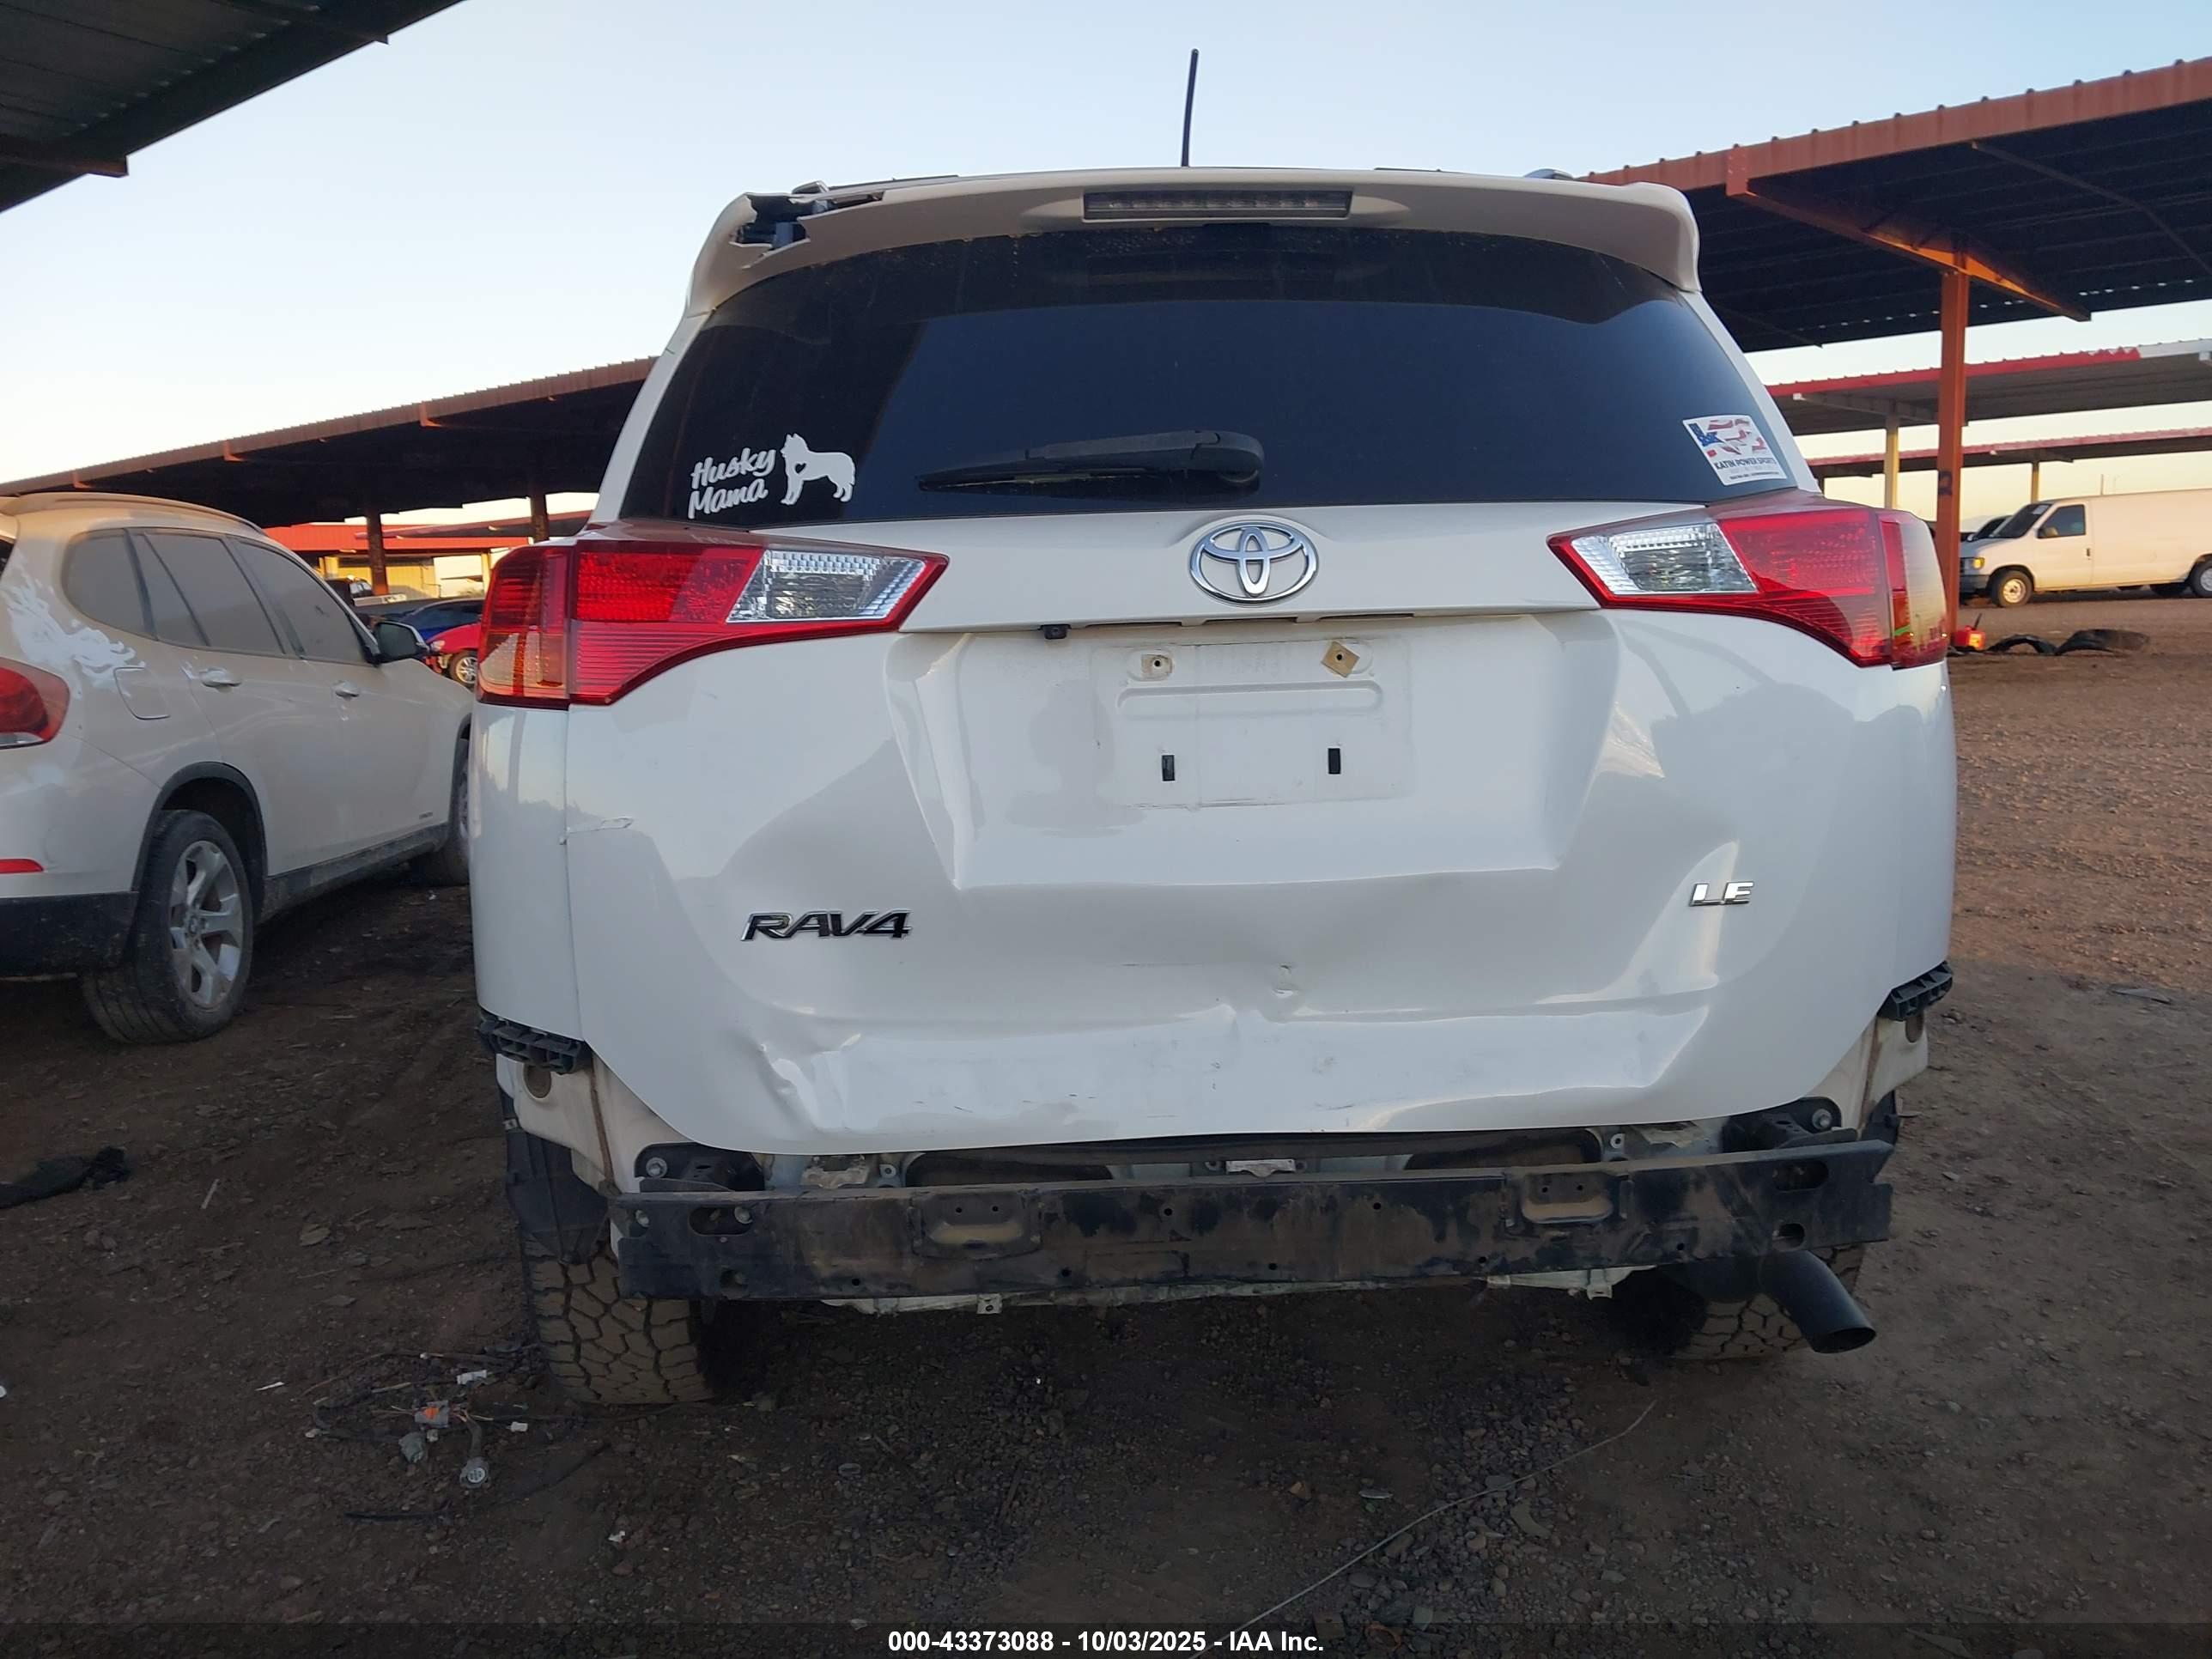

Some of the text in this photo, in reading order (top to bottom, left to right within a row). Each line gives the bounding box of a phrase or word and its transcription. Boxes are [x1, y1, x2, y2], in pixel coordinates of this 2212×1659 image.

[690, 447, 776, 489] Husky
[1735, 457, 1759, 467] POWER
[688, 478, 769, 520] Mama
[1688, 880, 1754, 907] LE
[740, 909, 913, 942] RAV4
